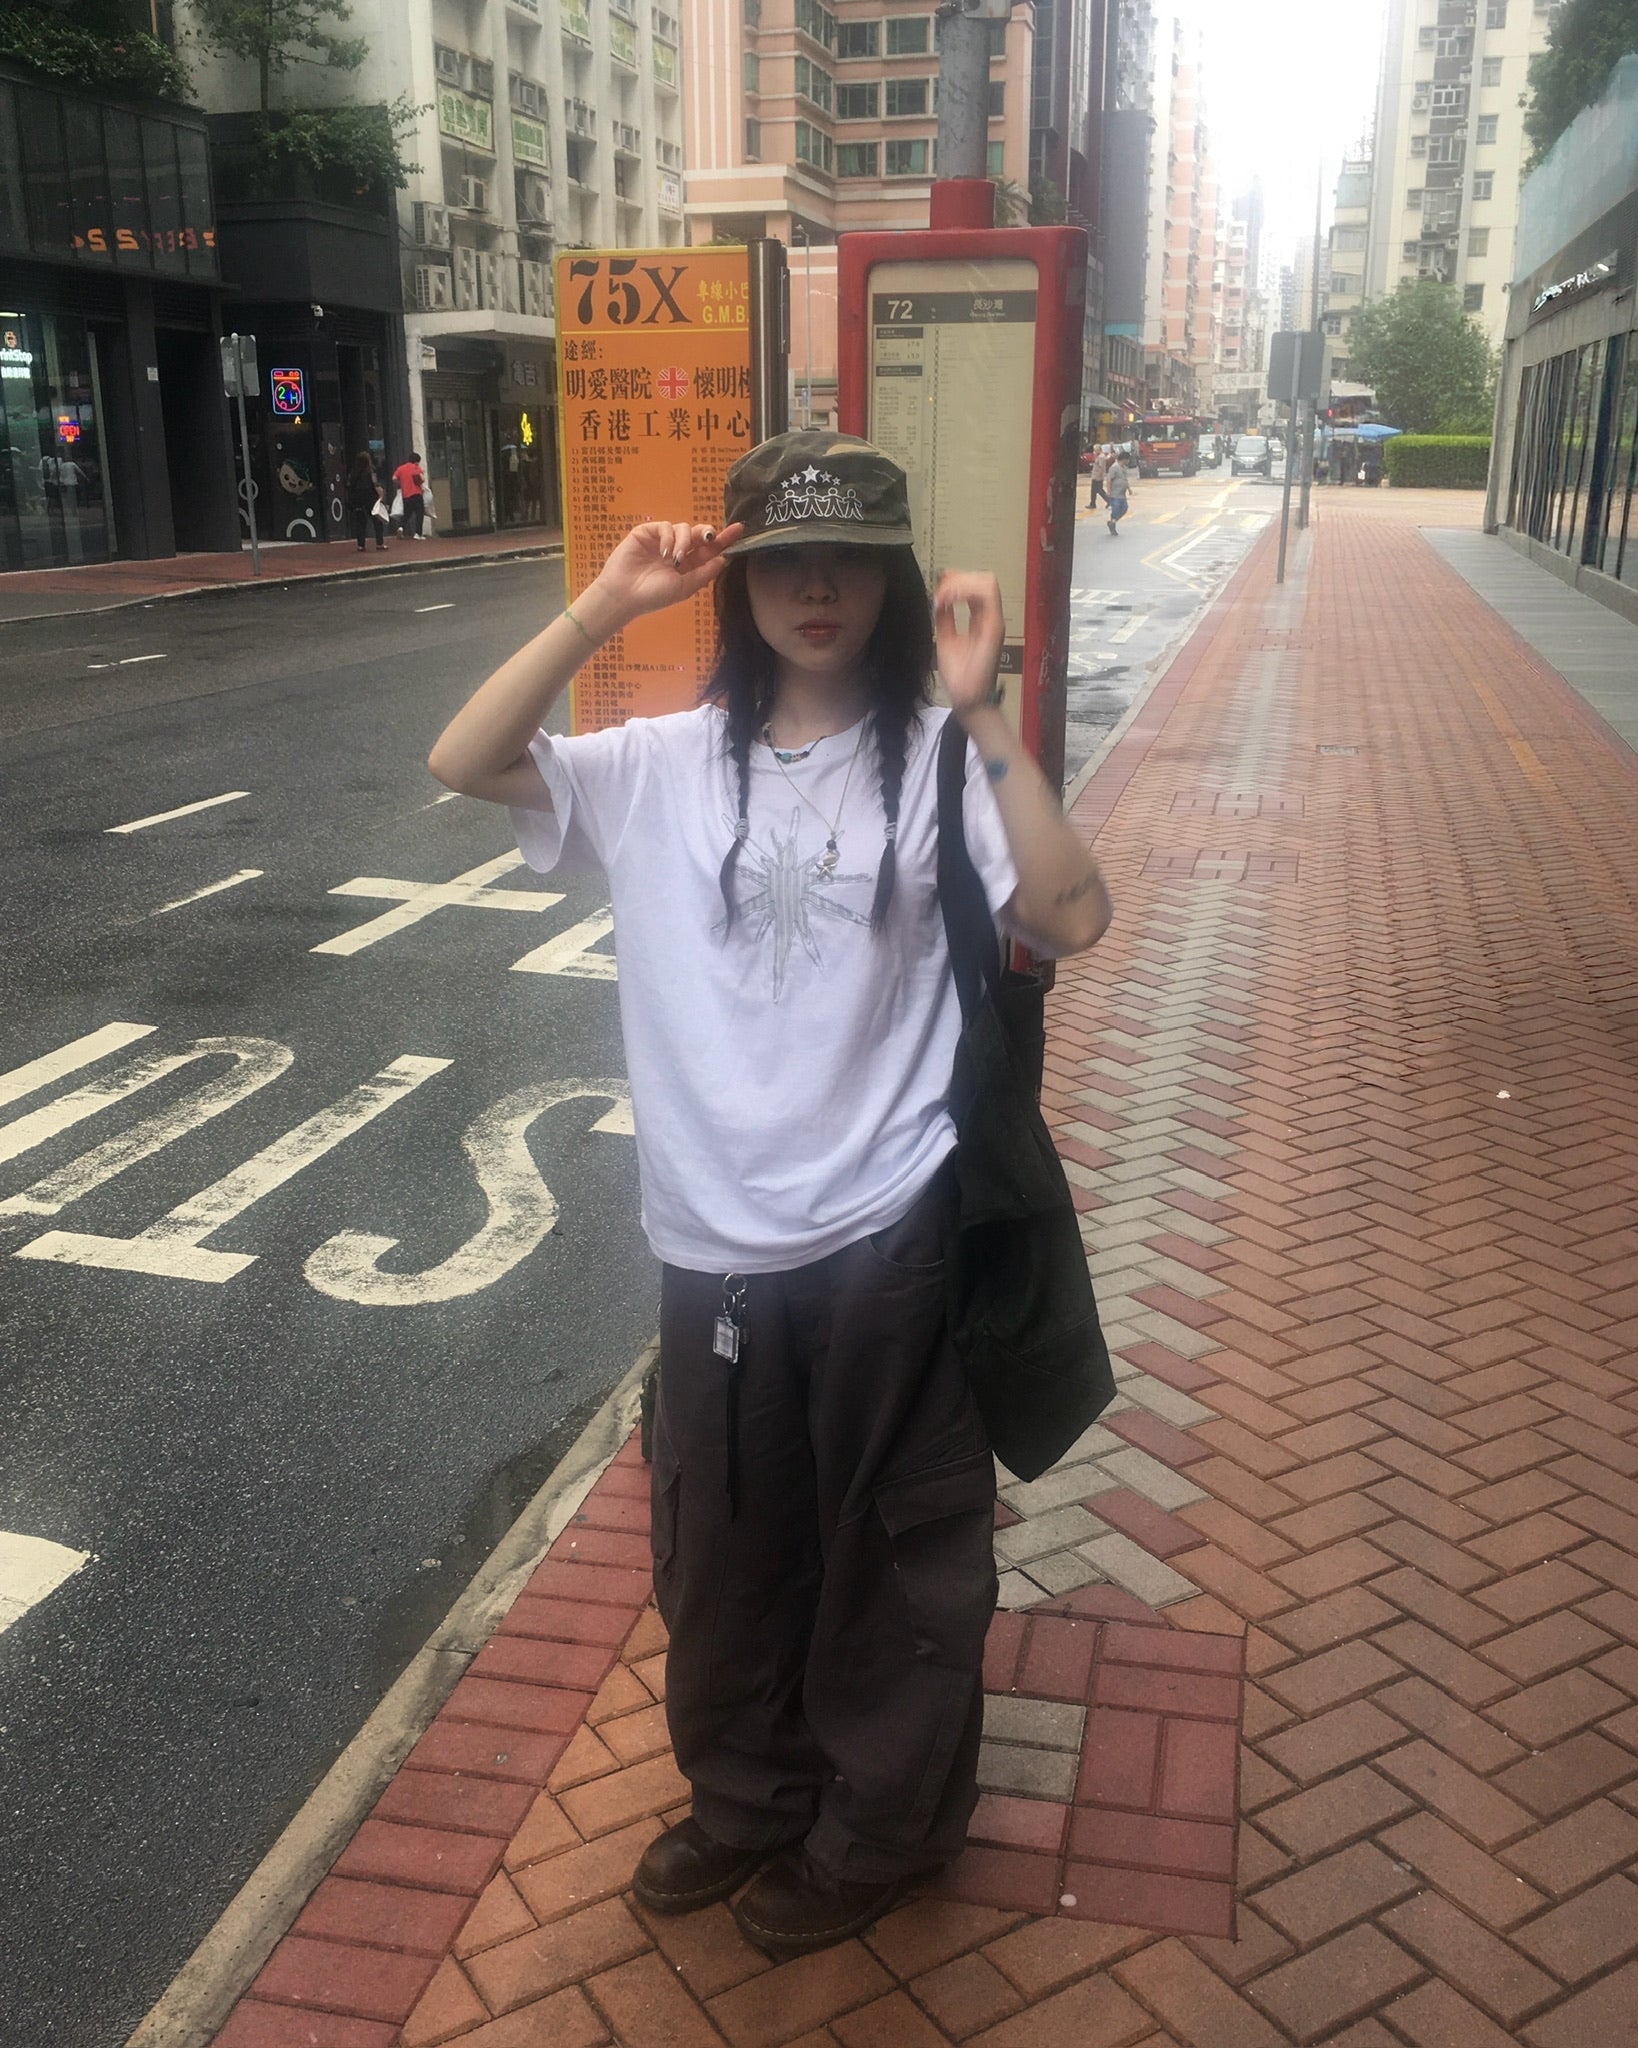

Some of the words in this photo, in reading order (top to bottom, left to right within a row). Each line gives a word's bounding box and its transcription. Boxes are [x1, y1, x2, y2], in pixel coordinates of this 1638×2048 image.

[570, 258, 692, 325] 75X
[697, 279, 749, 302] 專線小巴
[702, 305, 749, 324] G.M.B.
[887, 300, 913, 320] 72
[566, 366, 653, 400] 明愛醫院
[59, 425, 80, 436] OPEN
[579, 407, 751, 441] 香港工業中心
